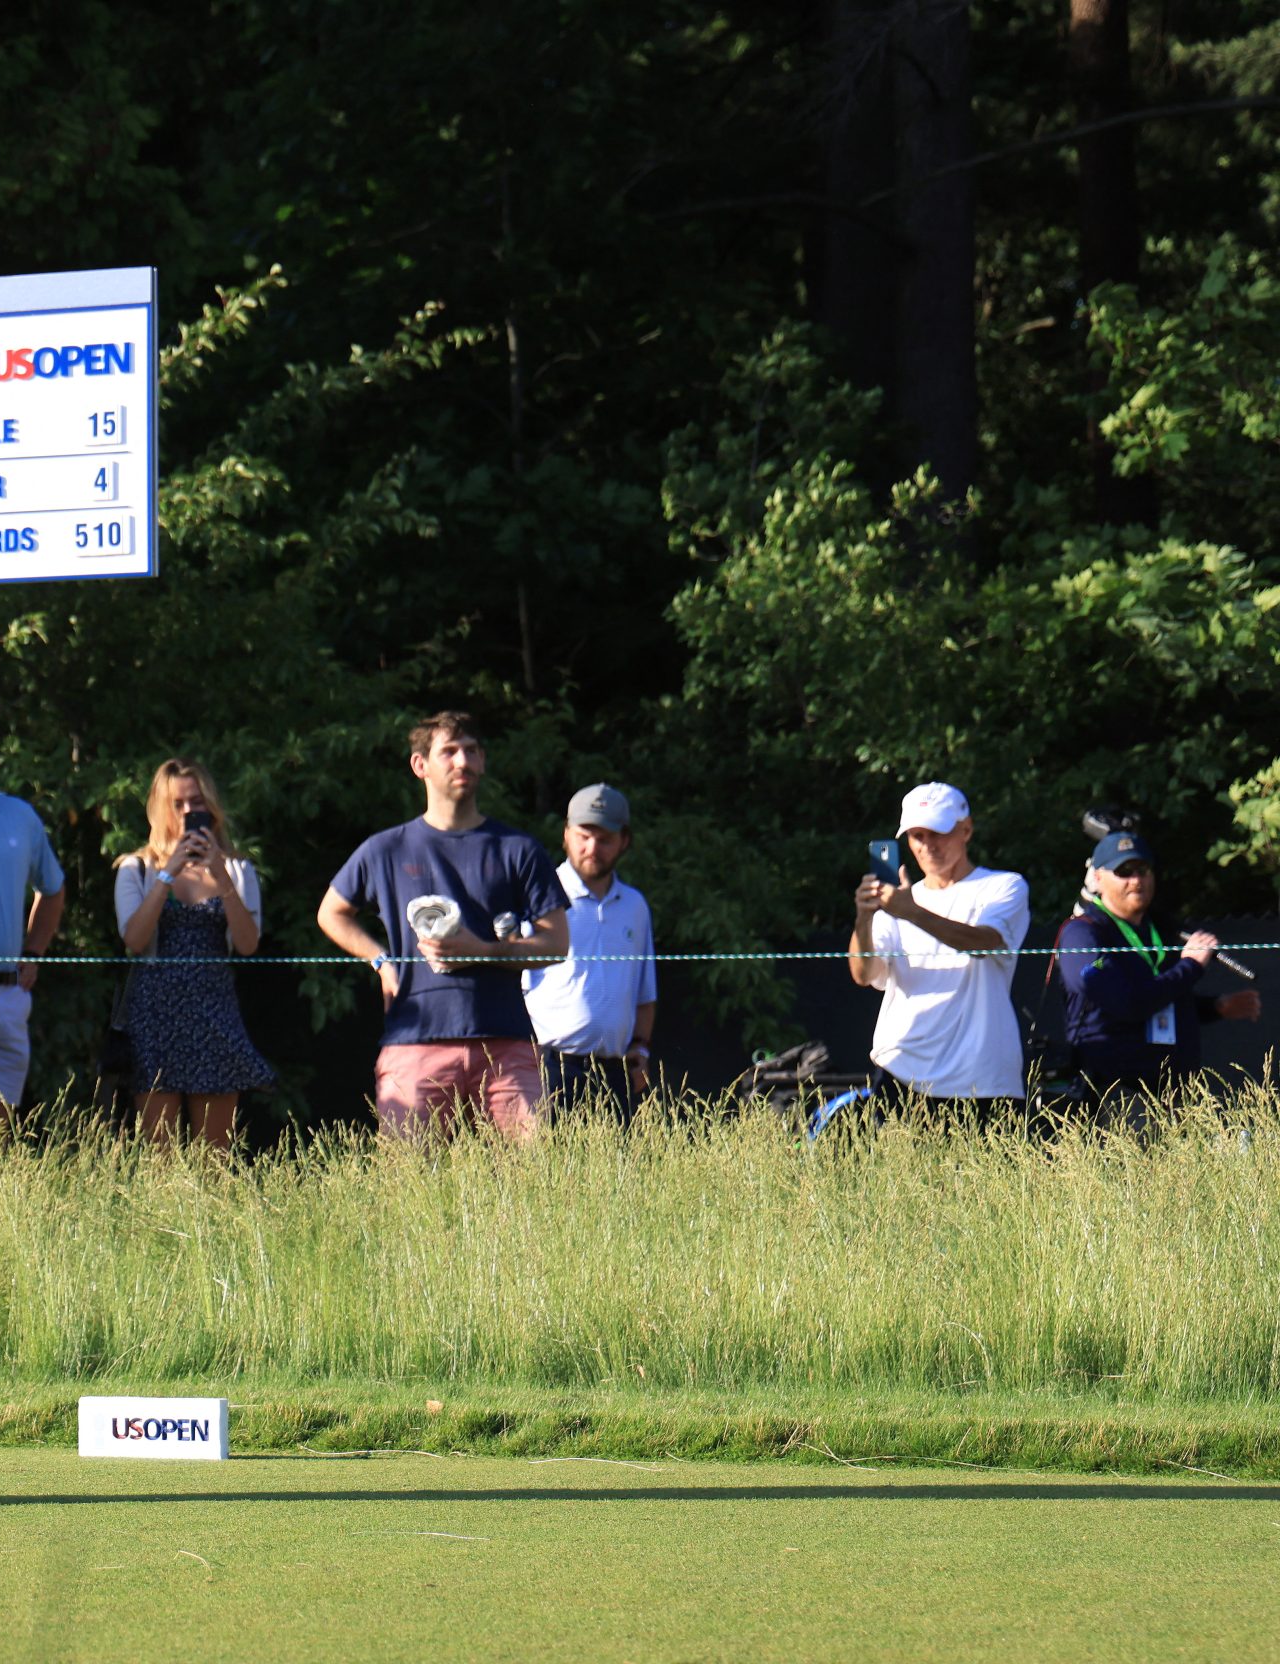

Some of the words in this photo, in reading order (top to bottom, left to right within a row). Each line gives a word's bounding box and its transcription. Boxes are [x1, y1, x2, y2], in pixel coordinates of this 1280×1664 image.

[88, 411, 116, 437] 15
[94, 467, 108, 492] 4
[75, 521, 121, 548] 510
